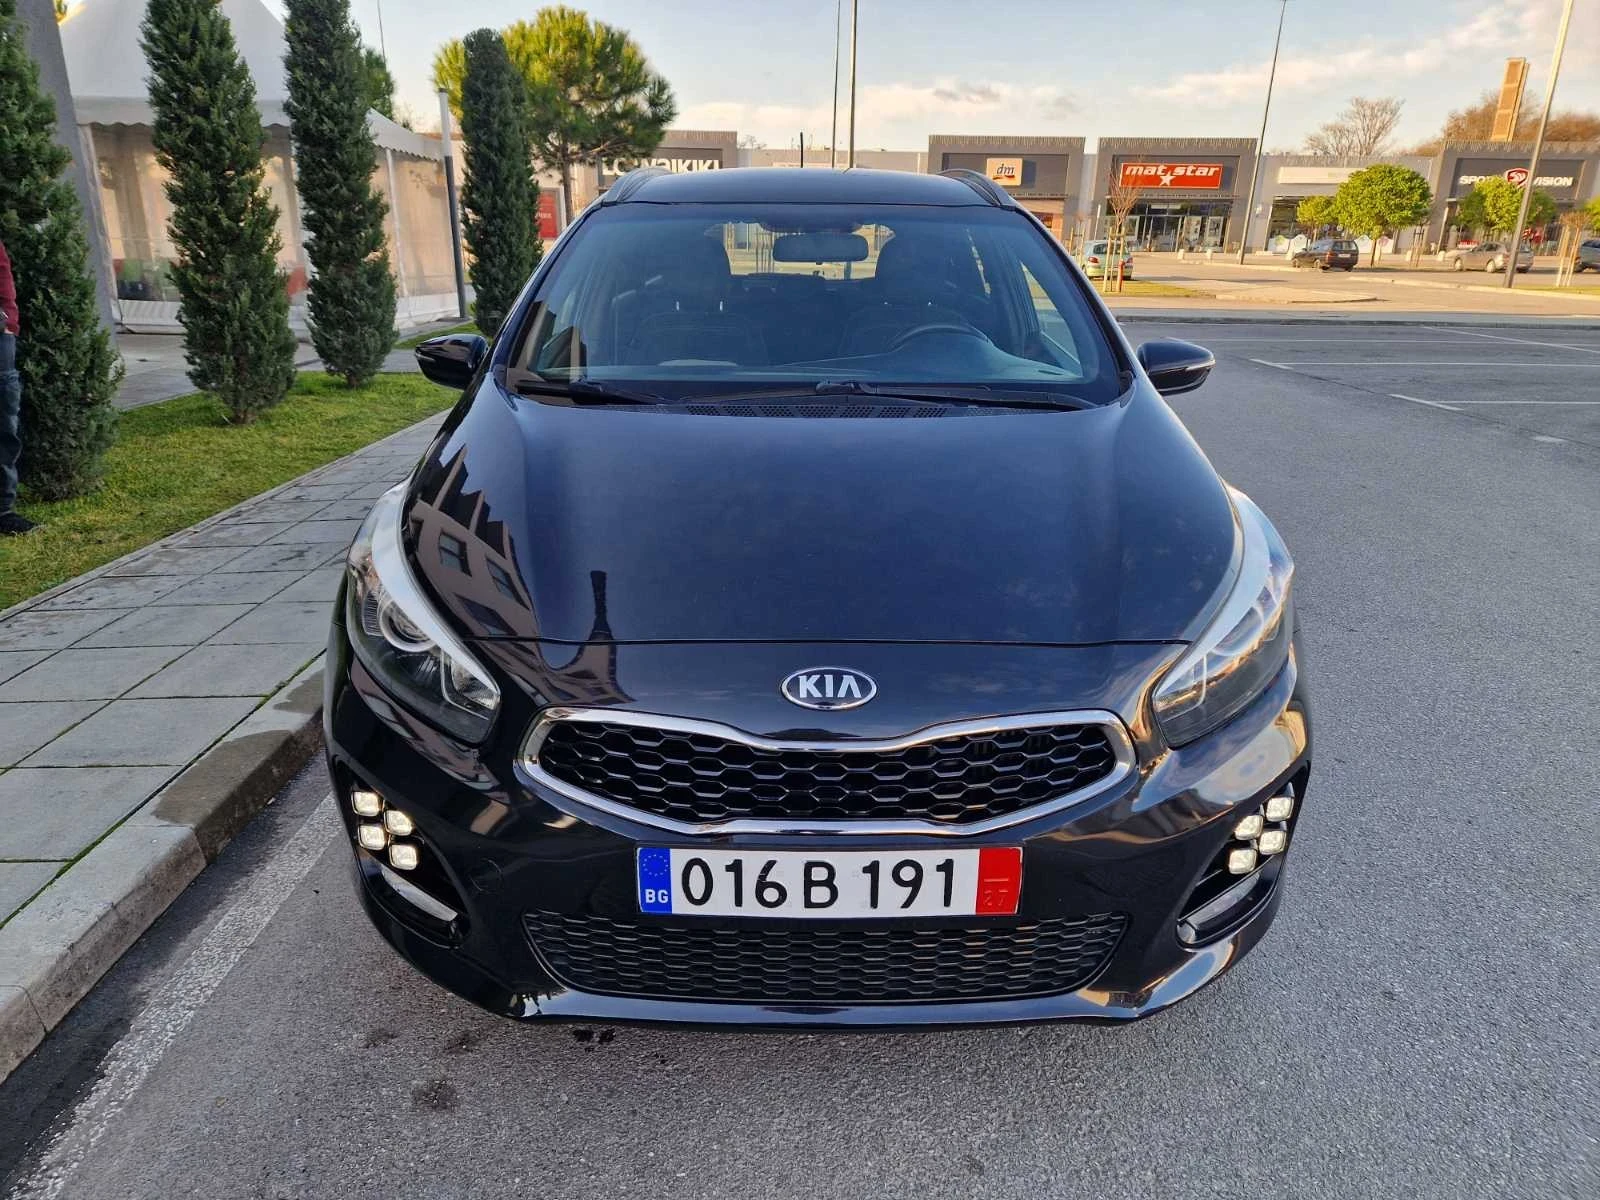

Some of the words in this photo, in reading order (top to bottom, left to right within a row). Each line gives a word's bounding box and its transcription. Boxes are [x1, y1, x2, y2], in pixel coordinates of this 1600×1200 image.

[996, 163, 1015, 175] dm
[1125, 164, 1168, 176] mat
[1171, 165, 1220, 177] star
[798, 674, 862, 699] KIA
[681, 857, 788, 909] 016
[803, 859, 839, 910] B
[861, 858, 955, 910] 191
[645, 888, 669, 904] BG
